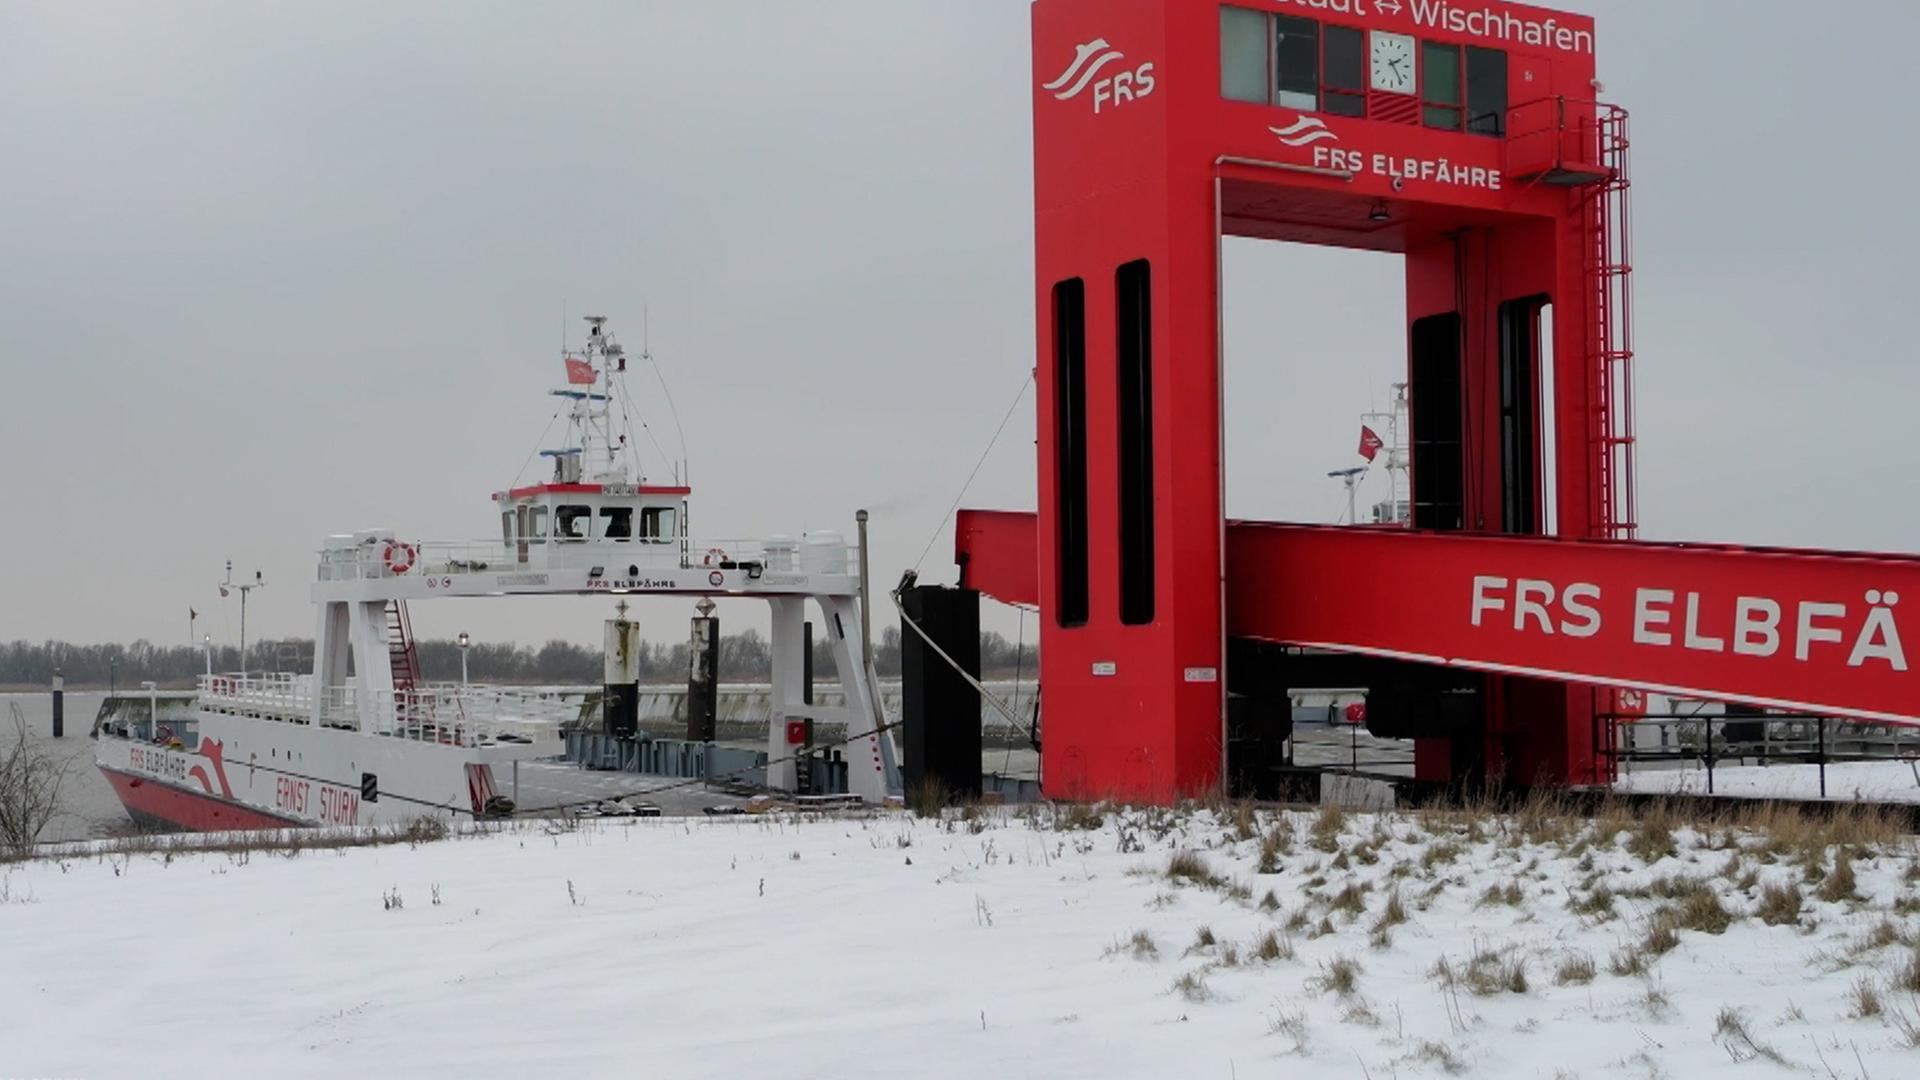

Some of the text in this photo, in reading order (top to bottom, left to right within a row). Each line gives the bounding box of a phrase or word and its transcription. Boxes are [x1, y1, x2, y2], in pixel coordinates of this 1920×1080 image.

[1410, 0, 1592, 54] Wischhafen
[1094, 62, 1155, 114] FRS
[1313, 145, 1501, 190] FRS ELBFÄHRE
[1471, 575, 1908, 671] FRS ELBFÄ
[276, 776, 360, 826] ERNST STURM
